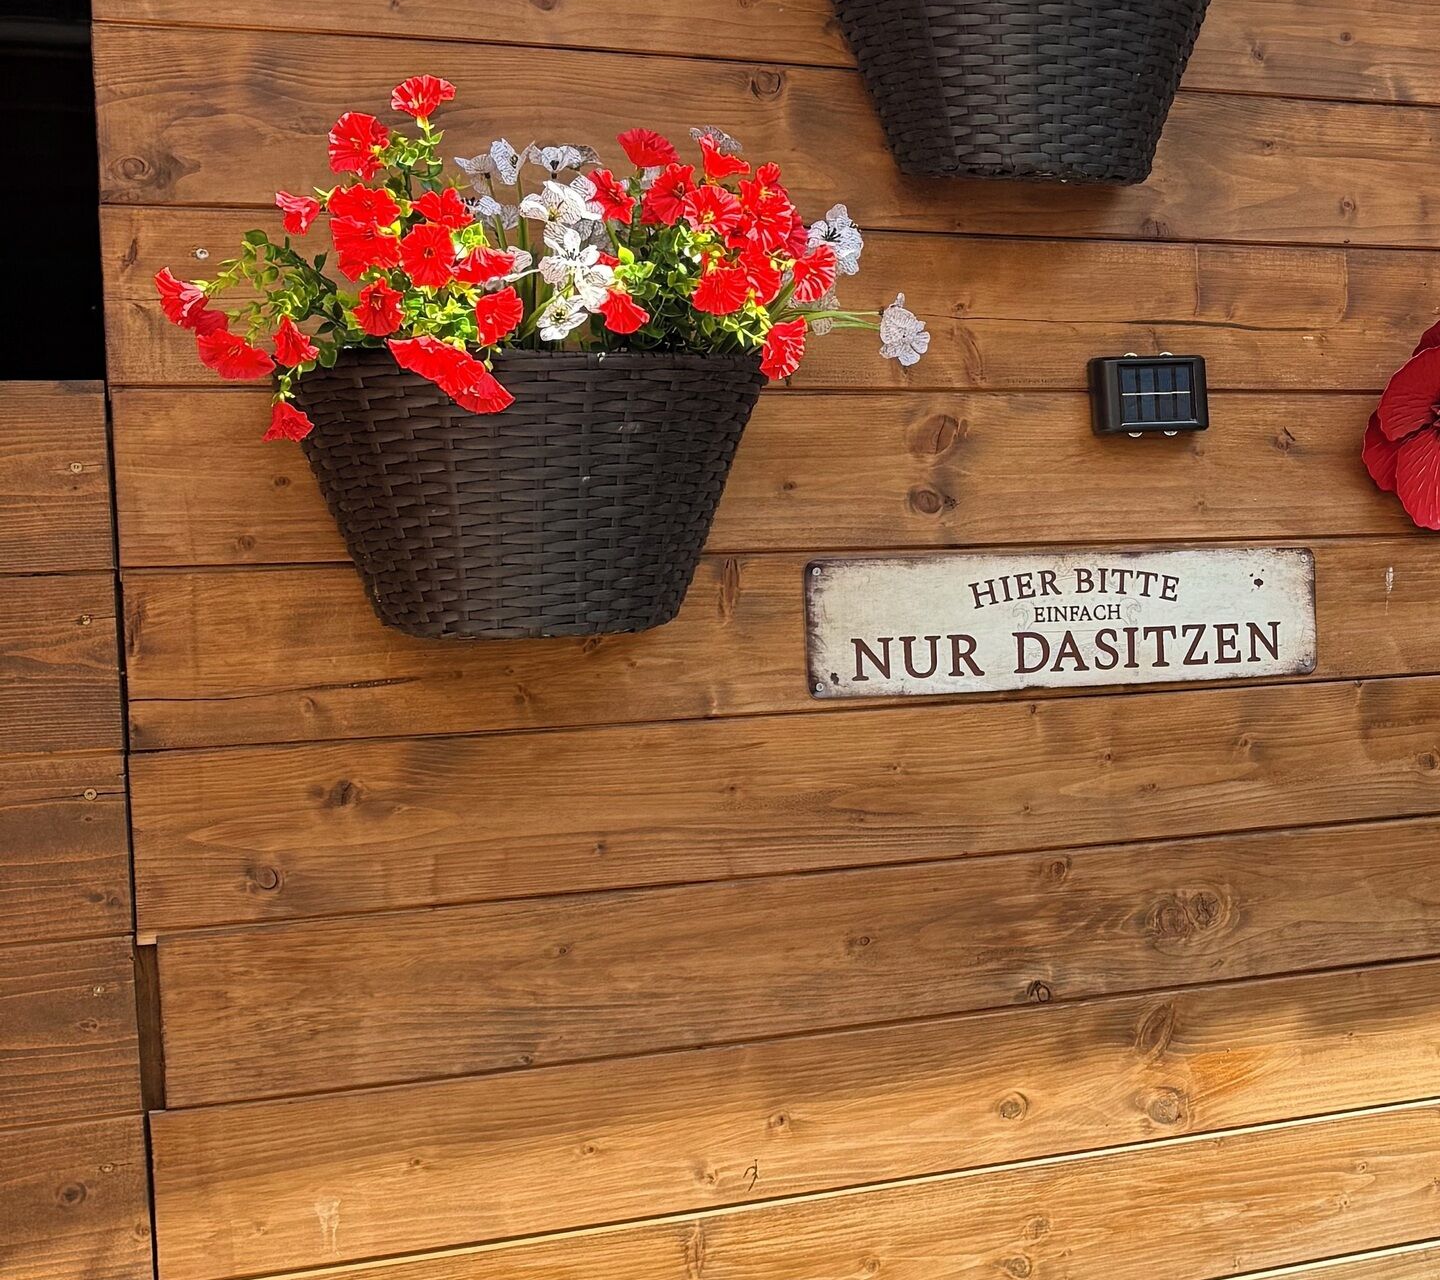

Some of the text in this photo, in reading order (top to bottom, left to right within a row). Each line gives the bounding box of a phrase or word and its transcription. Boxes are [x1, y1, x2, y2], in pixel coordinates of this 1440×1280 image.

[968, 568, 1181, 609] HIER BITTE
[1033, 603, 1122, 624] EINFACH
[850, 621, 1282, 682] NUR DASITZEN
